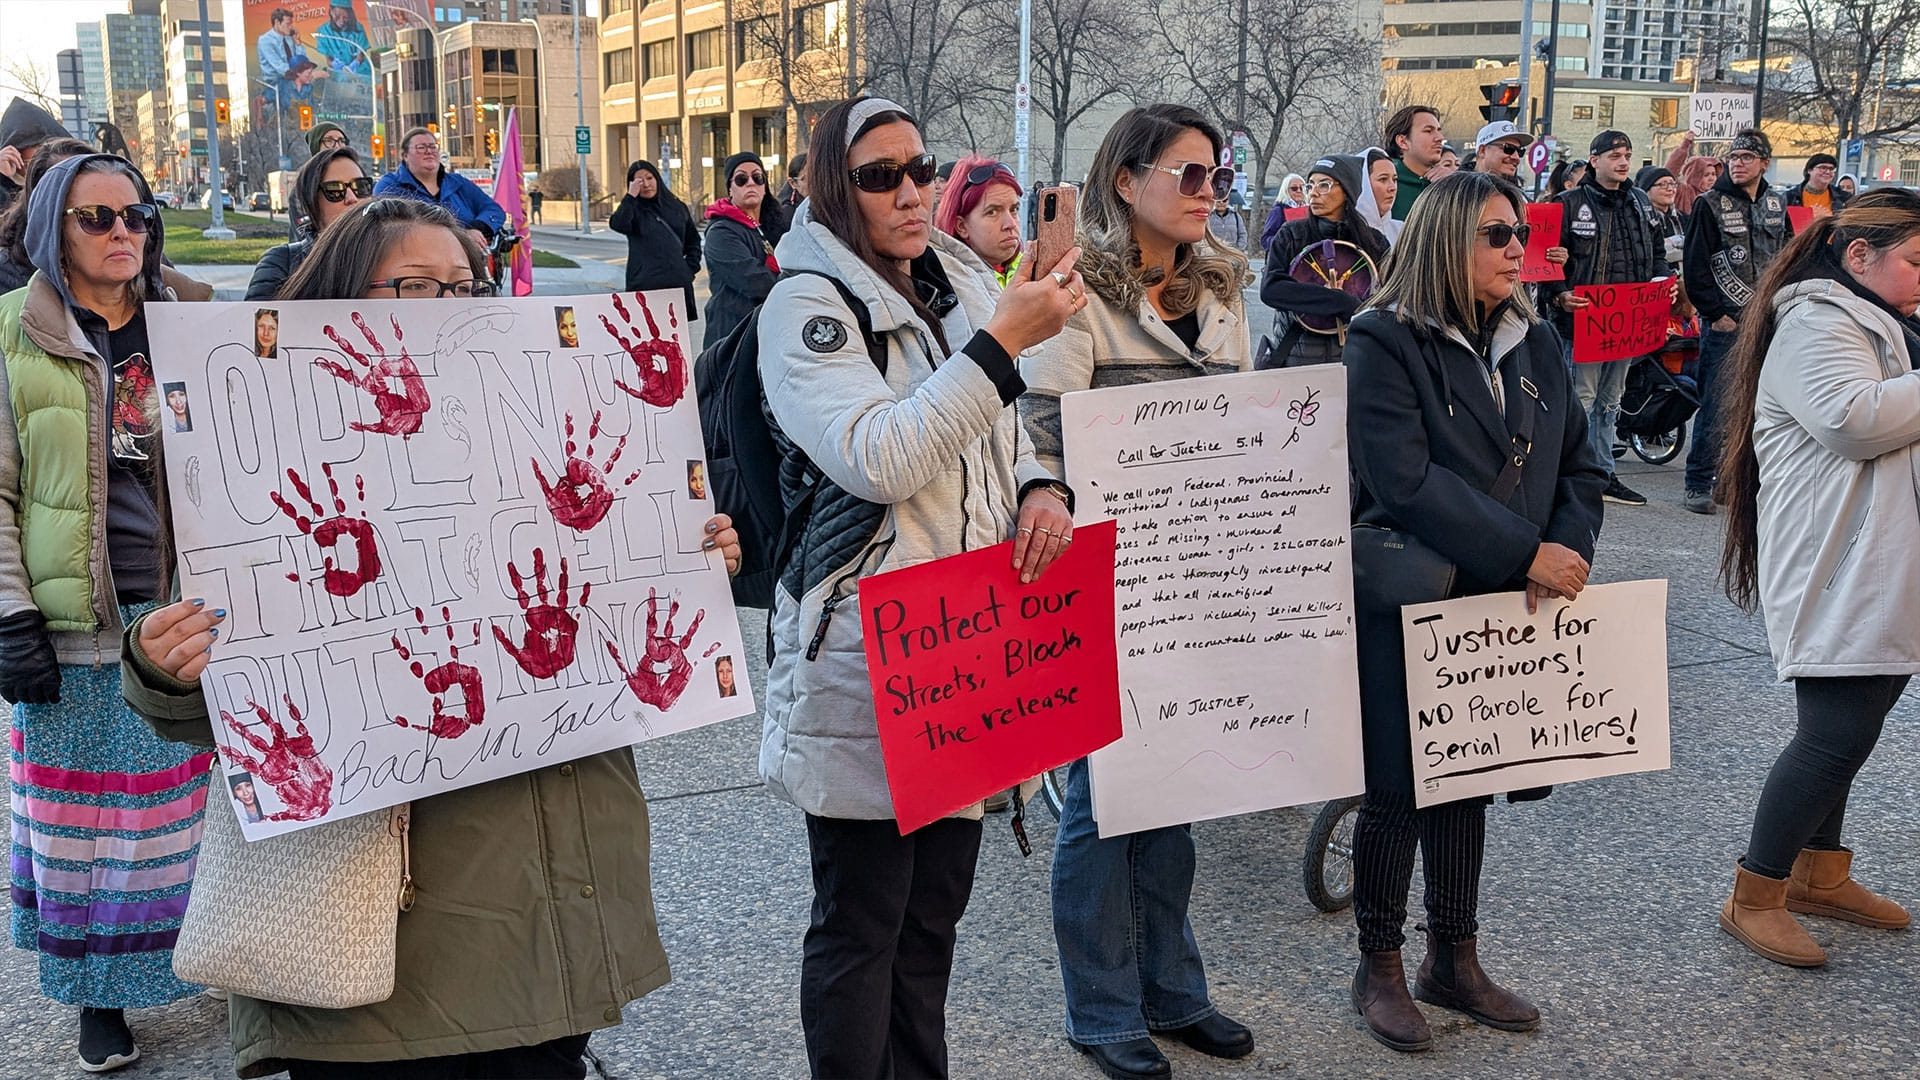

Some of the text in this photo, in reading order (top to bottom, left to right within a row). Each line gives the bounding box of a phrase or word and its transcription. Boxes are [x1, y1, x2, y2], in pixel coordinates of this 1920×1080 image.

[1695, 97, 1750, 112] NO PAROL
[1710, 112, 1733, 120] FOR
[1693, 119, 1727, 138] SHAWN
[1584, 282, 1672, 311] NO Justic
[1587, 311, 1625, 337] NO
[1134, 393, 1230, 425] MMIWG
[206, 343, 675, 524] OPEN UP
[1117, 431, 1263, 464] Call for Justice 5.14
[1102, 491, 1119, 503] We
[1123, 488, 1143, 501] call
[1147, 486, 1173, 497] upon
[1103, 497, 1169, 516] territorial
[1260, 483, 1332, 500] Governments
[1132, 518, 1158, 532] take
[1167, 513, 1208, 527] action
[1218, 513, 1230, 522] to
[1236, 509, 1274, 520] ensure
[1281, 504, 1297, 517] all
[1115, 540, 1139, 550] ases
[1147, 533, 1159, 546] of
[1227, 542, 1254, 561] girls
[183, 490, 711, 646] THAT CELL
[1115, 573, 1149, 592] people
[1157, 572, 1176, 581] are
[1122, 585, 1274, 612] and that all identified
[873, 585, 1083, 666] Protect our
[1412, 605, 1598, 663] Justice for
[1127, 647, 1146, 658] are
[1152, 639, 1177, 654] held
[1184, 632, 1256, 651] accountable
[1263, 630, 1294, 643] under
[1299, 628, 1318, 639] the
[1436, 644, 1585, 690] Survivors!
[206, 628, 397, 769] PUT
[1158, 694, 1255, 720] NO JUSTICE,
[1418, 682, 1615, 731] NO Parole for
[914, 685, 1080, 751] the release
[1222, 720, 1239, 734] NO
[1249, 713, 1295, 730] PEACE
[1424, 707, 1638, 768] Serial Killers!
[338, 715, 445, 806] Back
